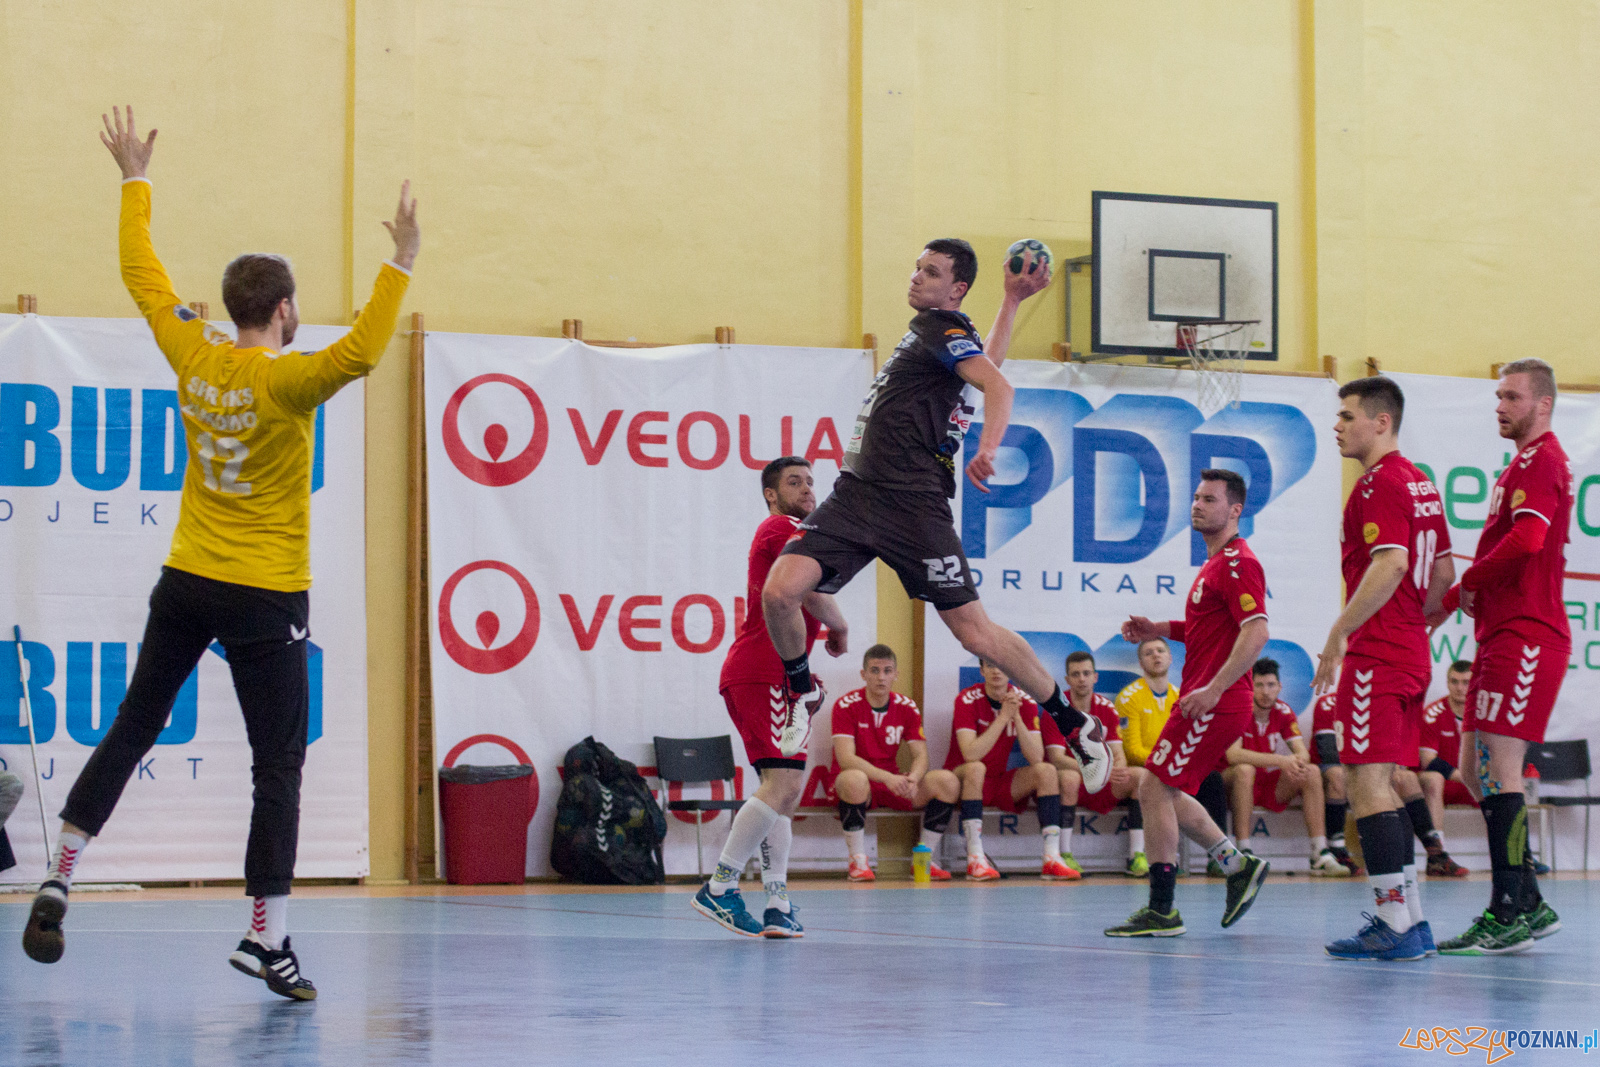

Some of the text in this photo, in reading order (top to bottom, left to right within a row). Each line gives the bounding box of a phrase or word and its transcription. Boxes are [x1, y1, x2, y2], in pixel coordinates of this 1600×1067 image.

[196, 431, 252, 495] 12
[566, 407, 846, 471] VEOLIA
[961, 421, 1273, 567] PDP
[922, 554, 965, 583] 22
[1475, 689, 1503, 721] 97
[1153, 738, 1172, 766] 3
